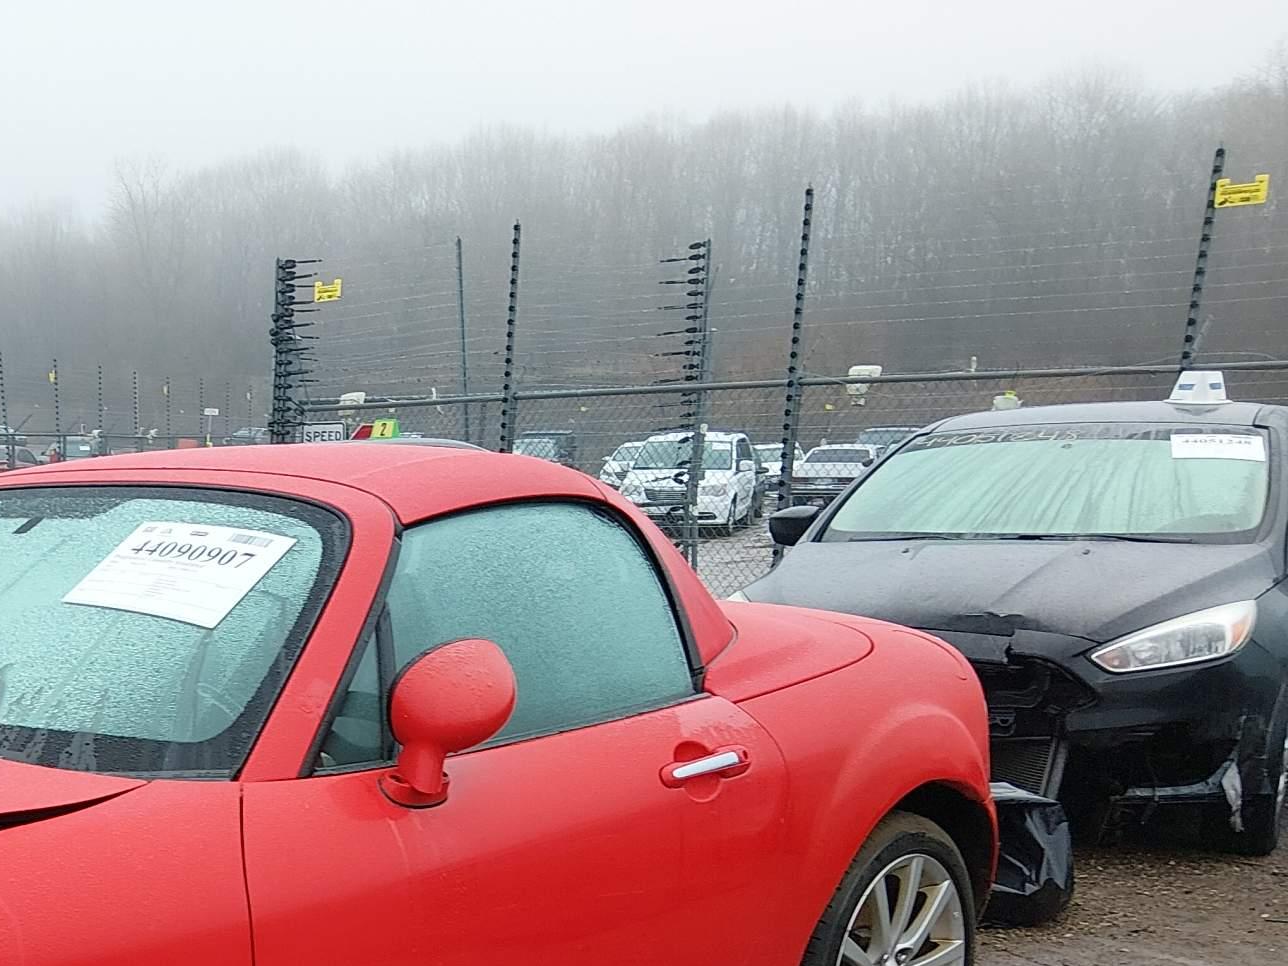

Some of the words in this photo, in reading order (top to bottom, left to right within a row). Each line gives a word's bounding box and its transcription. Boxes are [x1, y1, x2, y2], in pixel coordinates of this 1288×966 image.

[305, 431, 342, 442] SPEED
[379, 422, 387, 436] 2
[917, 430, 1080, 447] 44051248
[131, 540, 256, 568] 44090907
